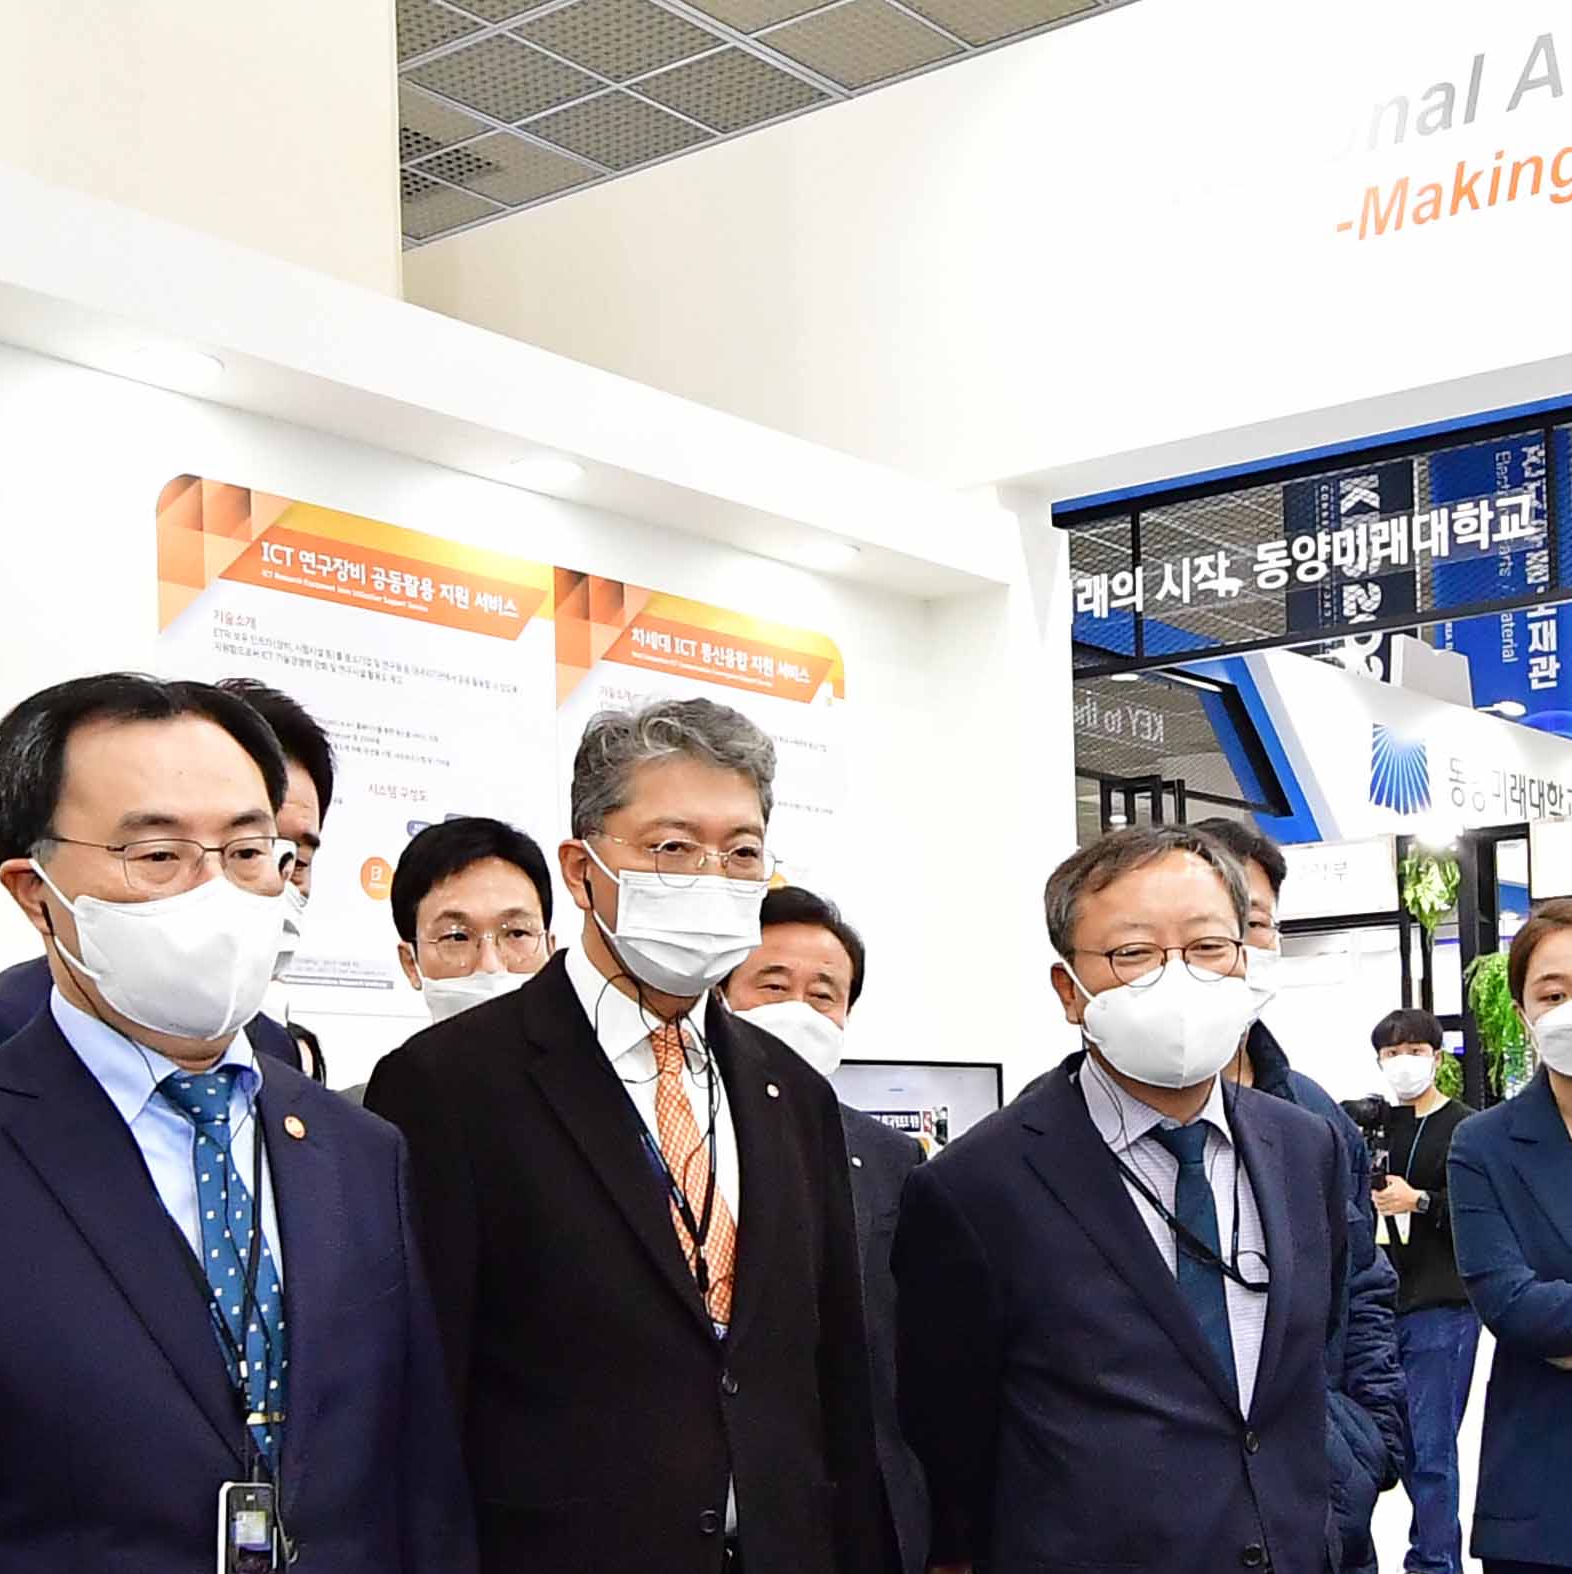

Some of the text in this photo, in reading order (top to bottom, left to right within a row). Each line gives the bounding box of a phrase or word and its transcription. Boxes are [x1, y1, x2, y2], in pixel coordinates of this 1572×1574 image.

[1253, 493, 1537, 589] 동양미래대학교
[260, 540, 295, 567] ICT
[298, 550, 366, 585] 연구장비
[371, 566, 435, 602] 공동활용
[439, 583, 469, 610] 지원
[473, 590, 520, 619] 서비스
[674, 636, 697, 657] ICT
[1500, 612, 1519, 663] aterial
